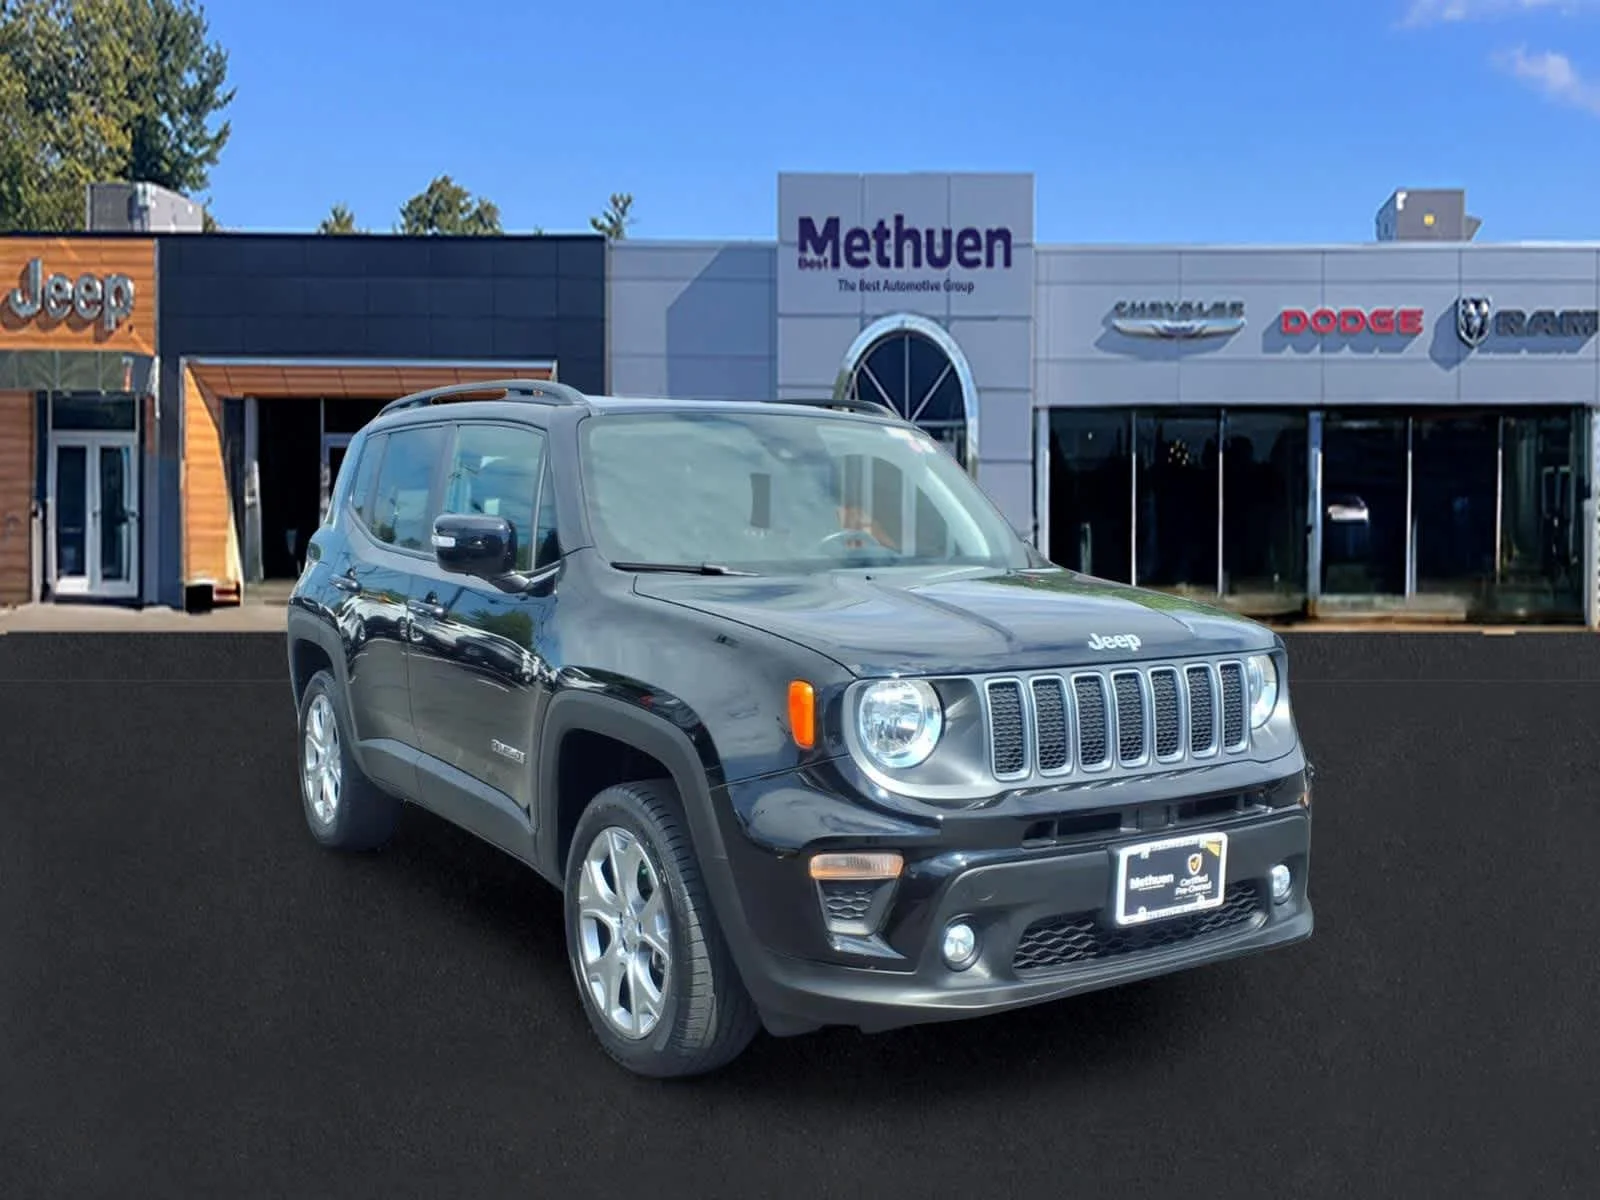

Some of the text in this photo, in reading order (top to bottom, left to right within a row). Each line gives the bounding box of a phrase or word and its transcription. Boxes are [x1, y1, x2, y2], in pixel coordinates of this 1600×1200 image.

[799, 214, 1012, 269] Methuen
[8, 257, 135, 331] Jeep
[838, 279, 975, 294] The Best Automotive Group
[1281, 309, 1423, 334] DODGE
[1495, 309, 1599, 337] RAM
[1087, 632, 1142, 652] Jeep
